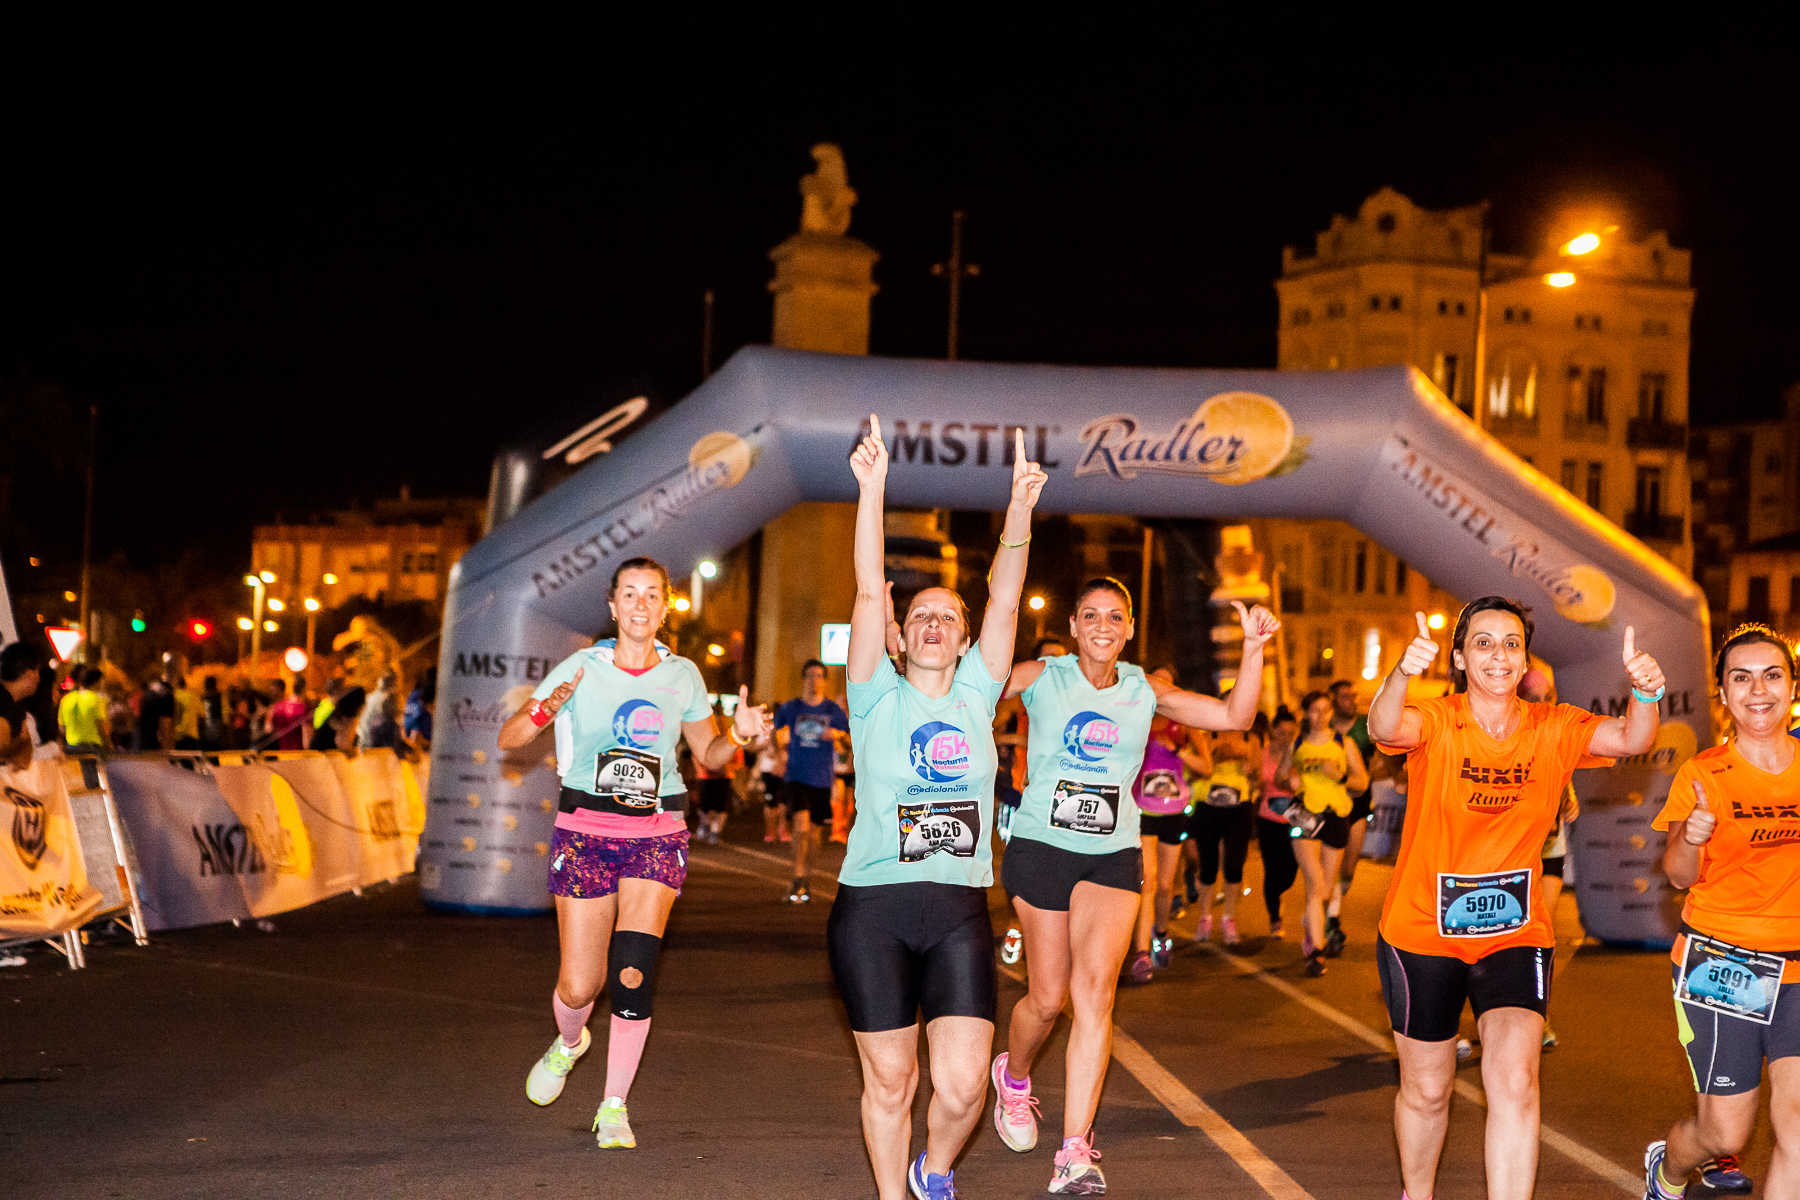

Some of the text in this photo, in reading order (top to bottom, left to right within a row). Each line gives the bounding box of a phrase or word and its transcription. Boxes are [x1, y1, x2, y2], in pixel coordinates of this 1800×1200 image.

[1077, 416, 1248, 480] Radler
[1394, 452, 1497, 546] AMSTEL
[531, 517, 645, 600] AMSTEL
[1590, 690, 1695, 718] AMEL
[632, 710, 664, 731] 15K
[1086, 721, 1120, 745] 15K
[931, 734, 971, 760] 15K
[613, 763, 645, 779] 9023
[932, 756, 968, 766] Nocturna
[907, 784, 968, 796] mediolanum
[1077, 800, 1099, 814] 757
[920, 821, 961, 840] 5626
[1466, 894, 1506, 912] 5970
[1708, 965, 1753, 990] 5991
